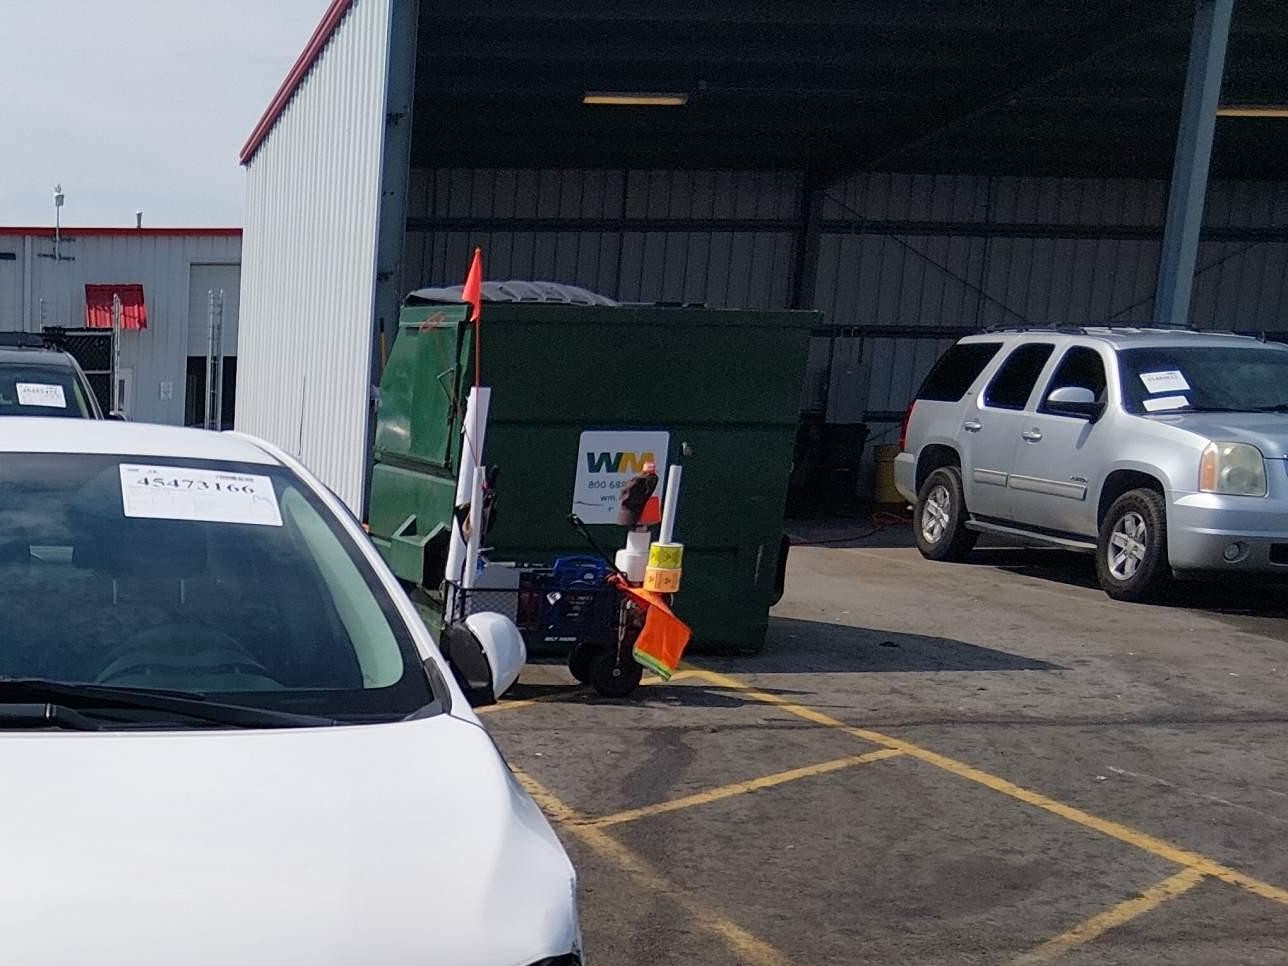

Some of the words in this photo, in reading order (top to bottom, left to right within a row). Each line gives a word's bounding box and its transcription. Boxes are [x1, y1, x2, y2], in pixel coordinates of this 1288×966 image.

[586, 451, 656, 473] WM
[137, 476, 256, 494] 45473166
[588, 480, 607, 489] 800
